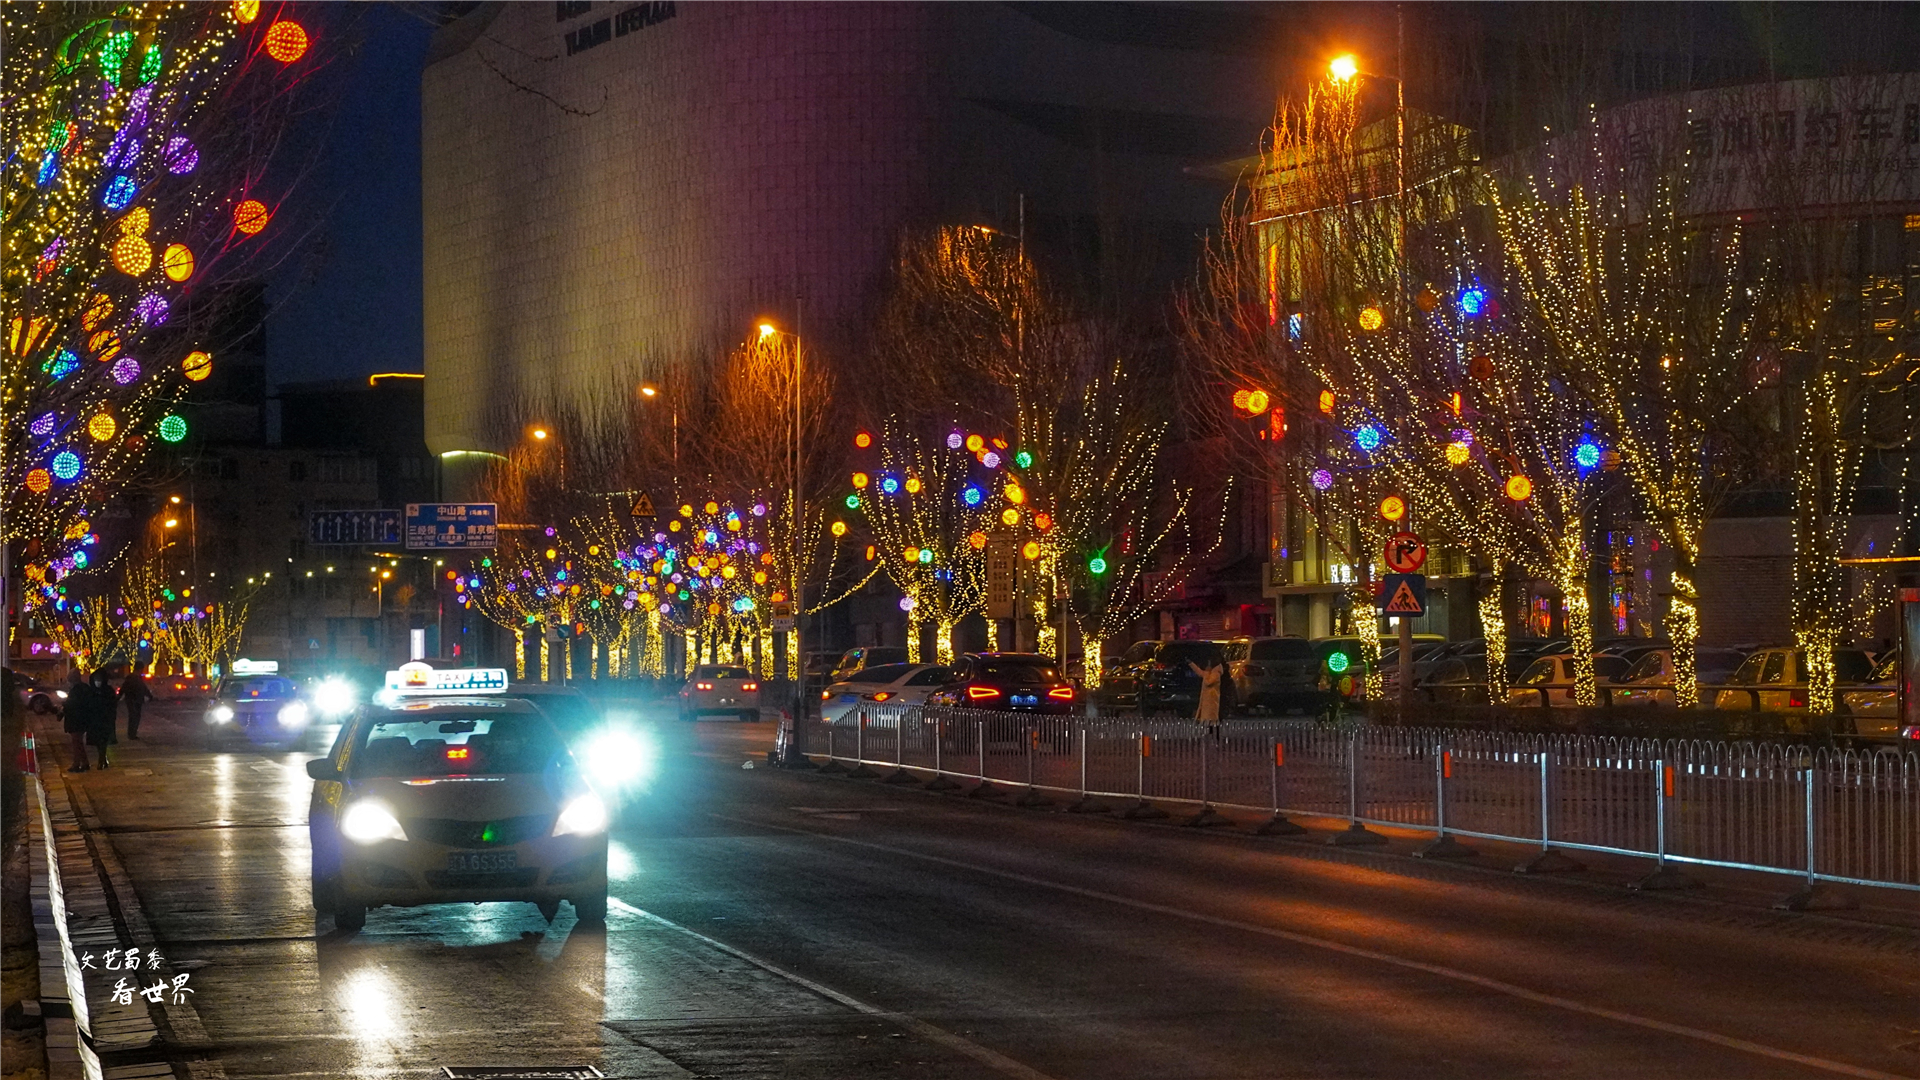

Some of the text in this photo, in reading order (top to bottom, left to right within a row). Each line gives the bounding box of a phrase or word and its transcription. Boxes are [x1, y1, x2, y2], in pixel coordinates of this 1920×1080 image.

[437, 506, 466, 516] 中山路
[437, 673, 466, 682] TAXI
